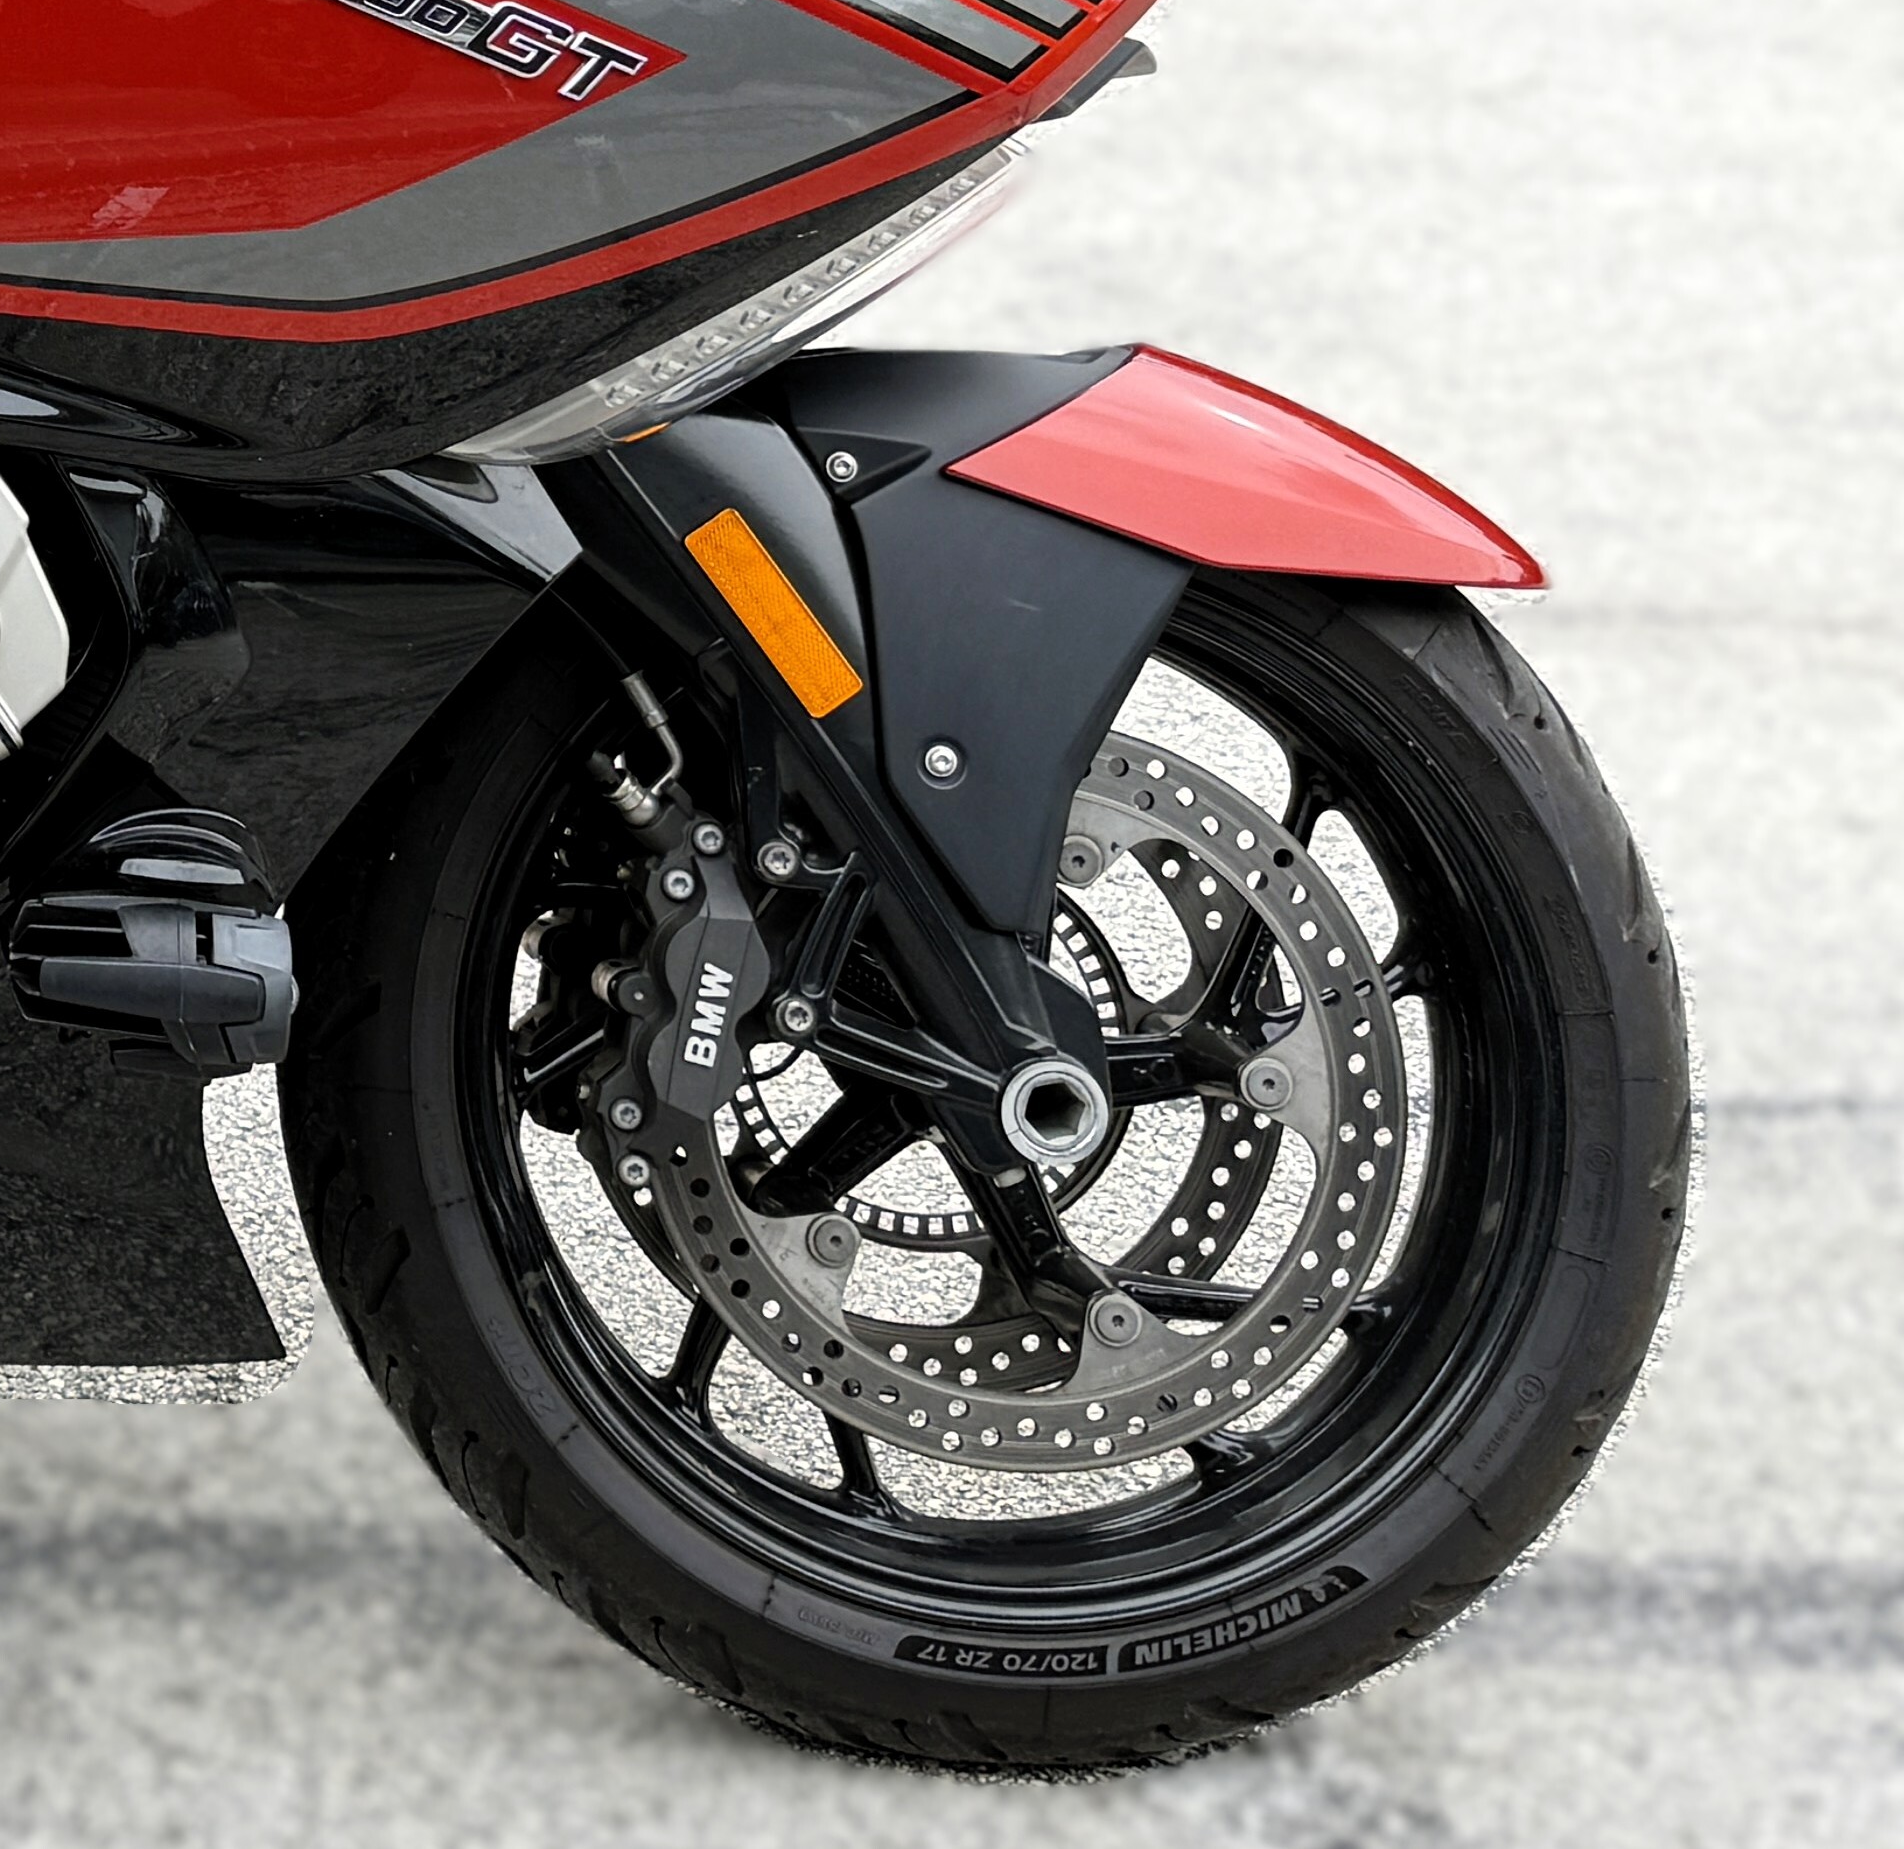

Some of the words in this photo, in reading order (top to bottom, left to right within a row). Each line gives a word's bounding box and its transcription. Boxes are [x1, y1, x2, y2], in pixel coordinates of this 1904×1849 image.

[684, 962, 734, 1068] BMW
[1135, 1594, 1302, 1665] MICHELIN
[917, 1641, 948, 1663] 17
[954, 1646, 994, 1668] ZR
[1004, 1652, 1098, 1675] 120/70
